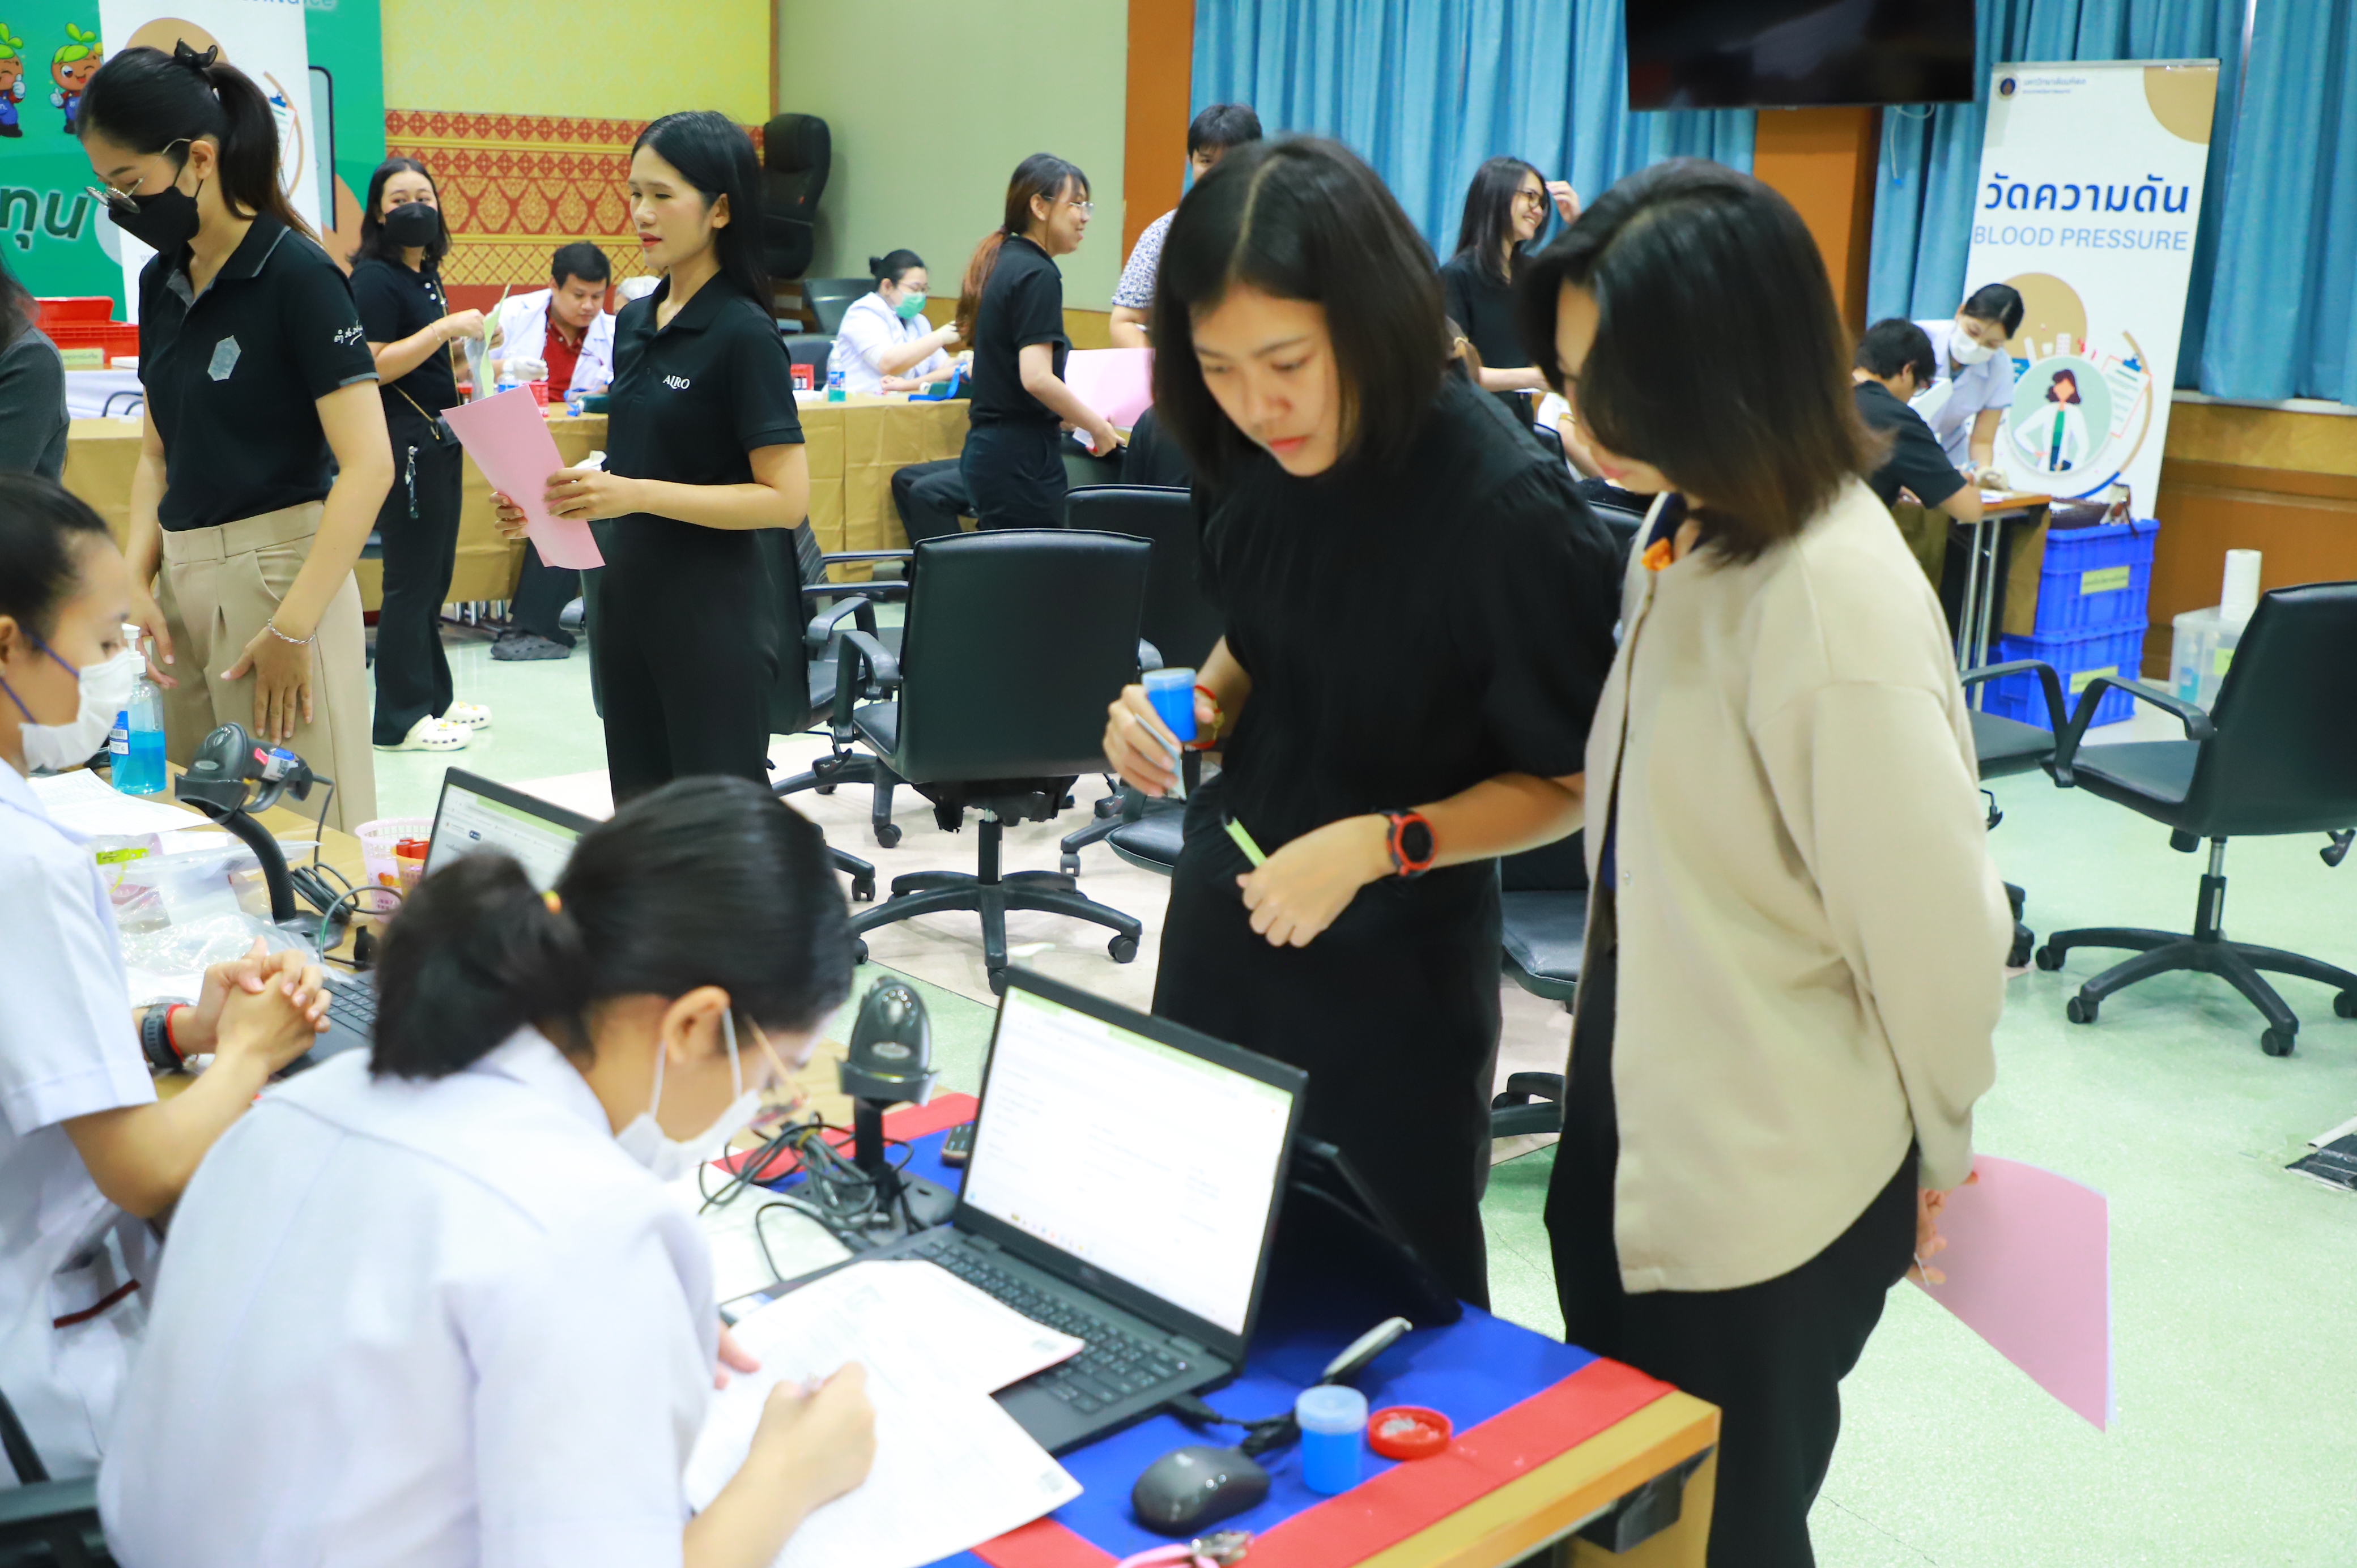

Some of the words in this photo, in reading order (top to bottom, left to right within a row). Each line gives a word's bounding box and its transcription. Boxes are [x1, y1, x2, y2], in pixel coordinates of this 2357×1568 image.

[1985, 172, 2189, 213] วัดความดัน
[1974, 225, 2054, 246] BLOOD
[2060, 228, 2189, 250] PRESSURE
